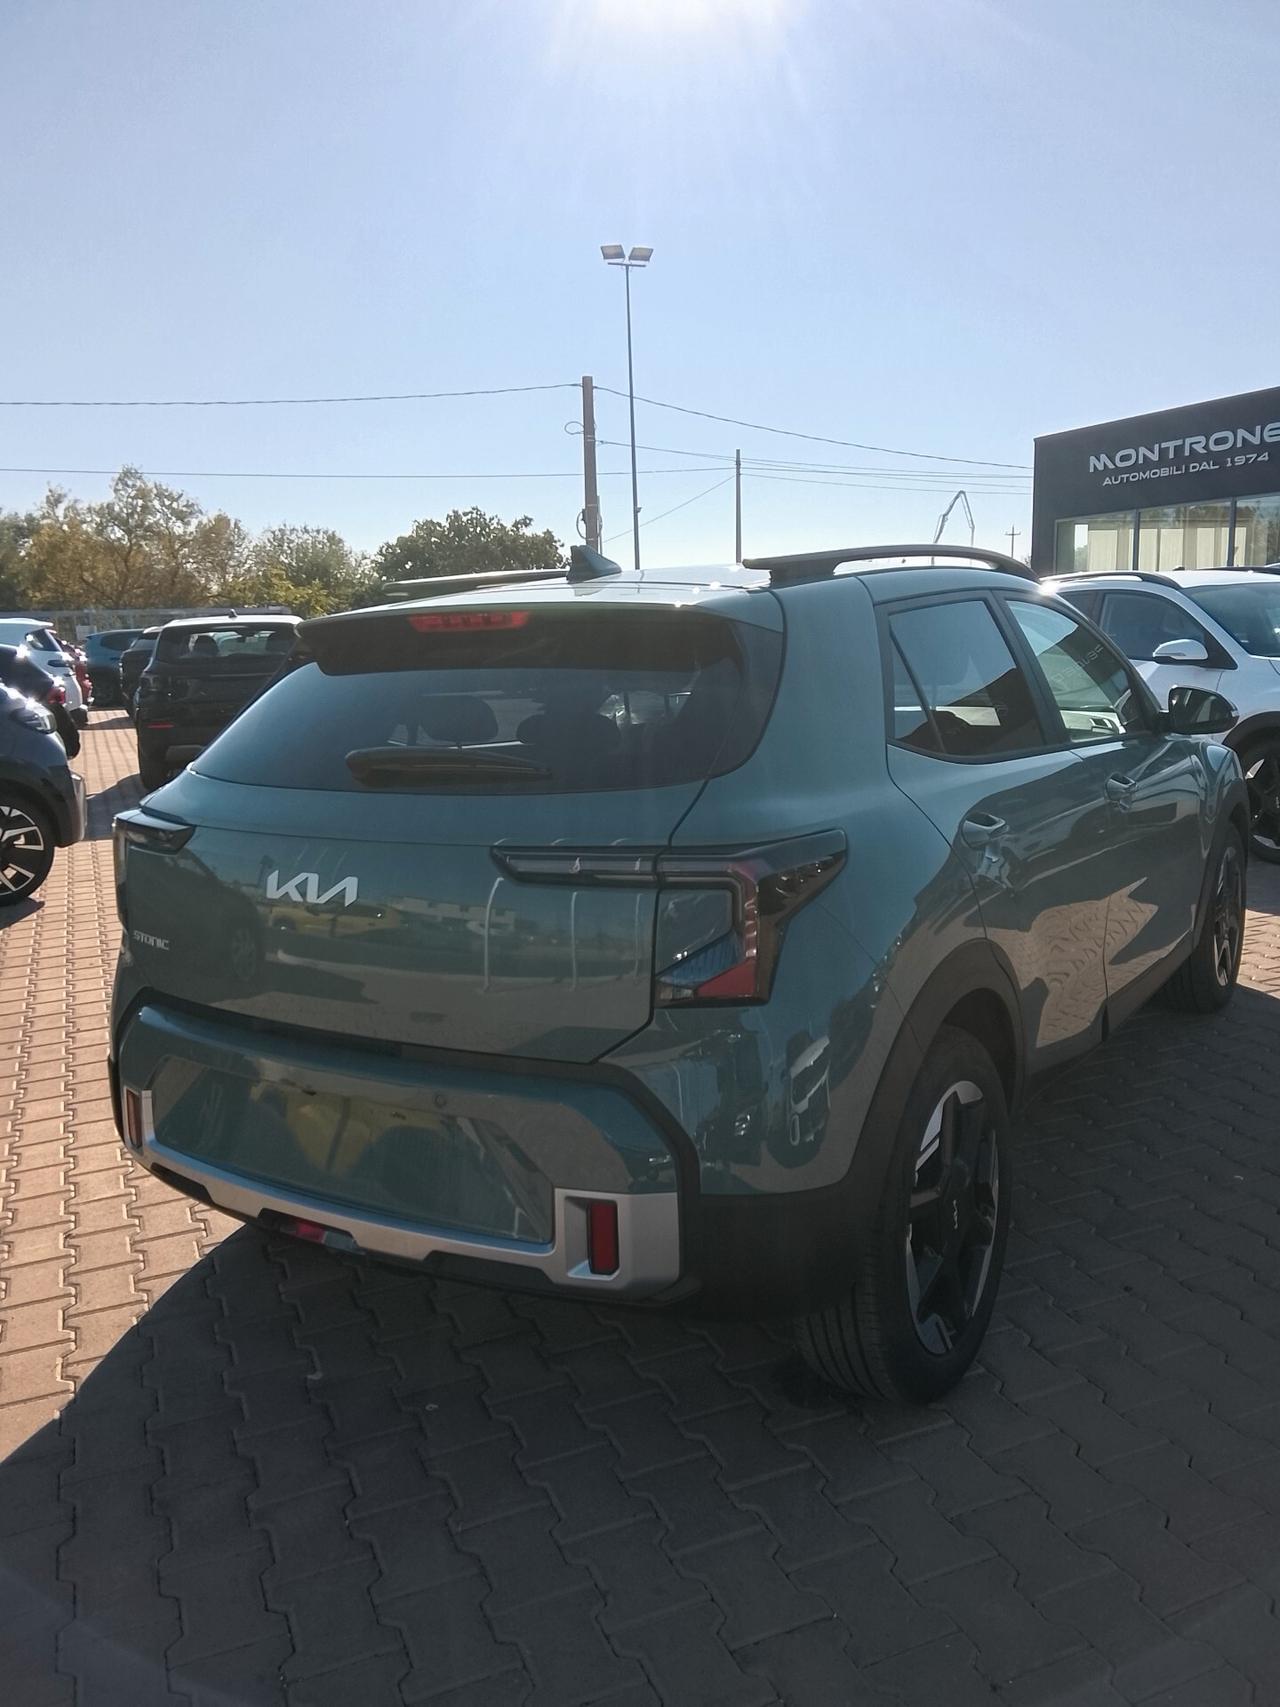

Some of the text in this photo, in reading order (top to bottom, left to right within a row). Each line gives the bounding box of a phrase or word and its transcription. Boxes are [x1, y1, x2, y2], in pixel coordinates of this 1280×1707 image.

[1089, 422, 1280, 473] MONTRONE
[1102, 451, 1269, 487] AUTOMOBILI DAL 1974
[266, 870, 359, 907] KIA
[133, 929, 170, 951] STONIC
